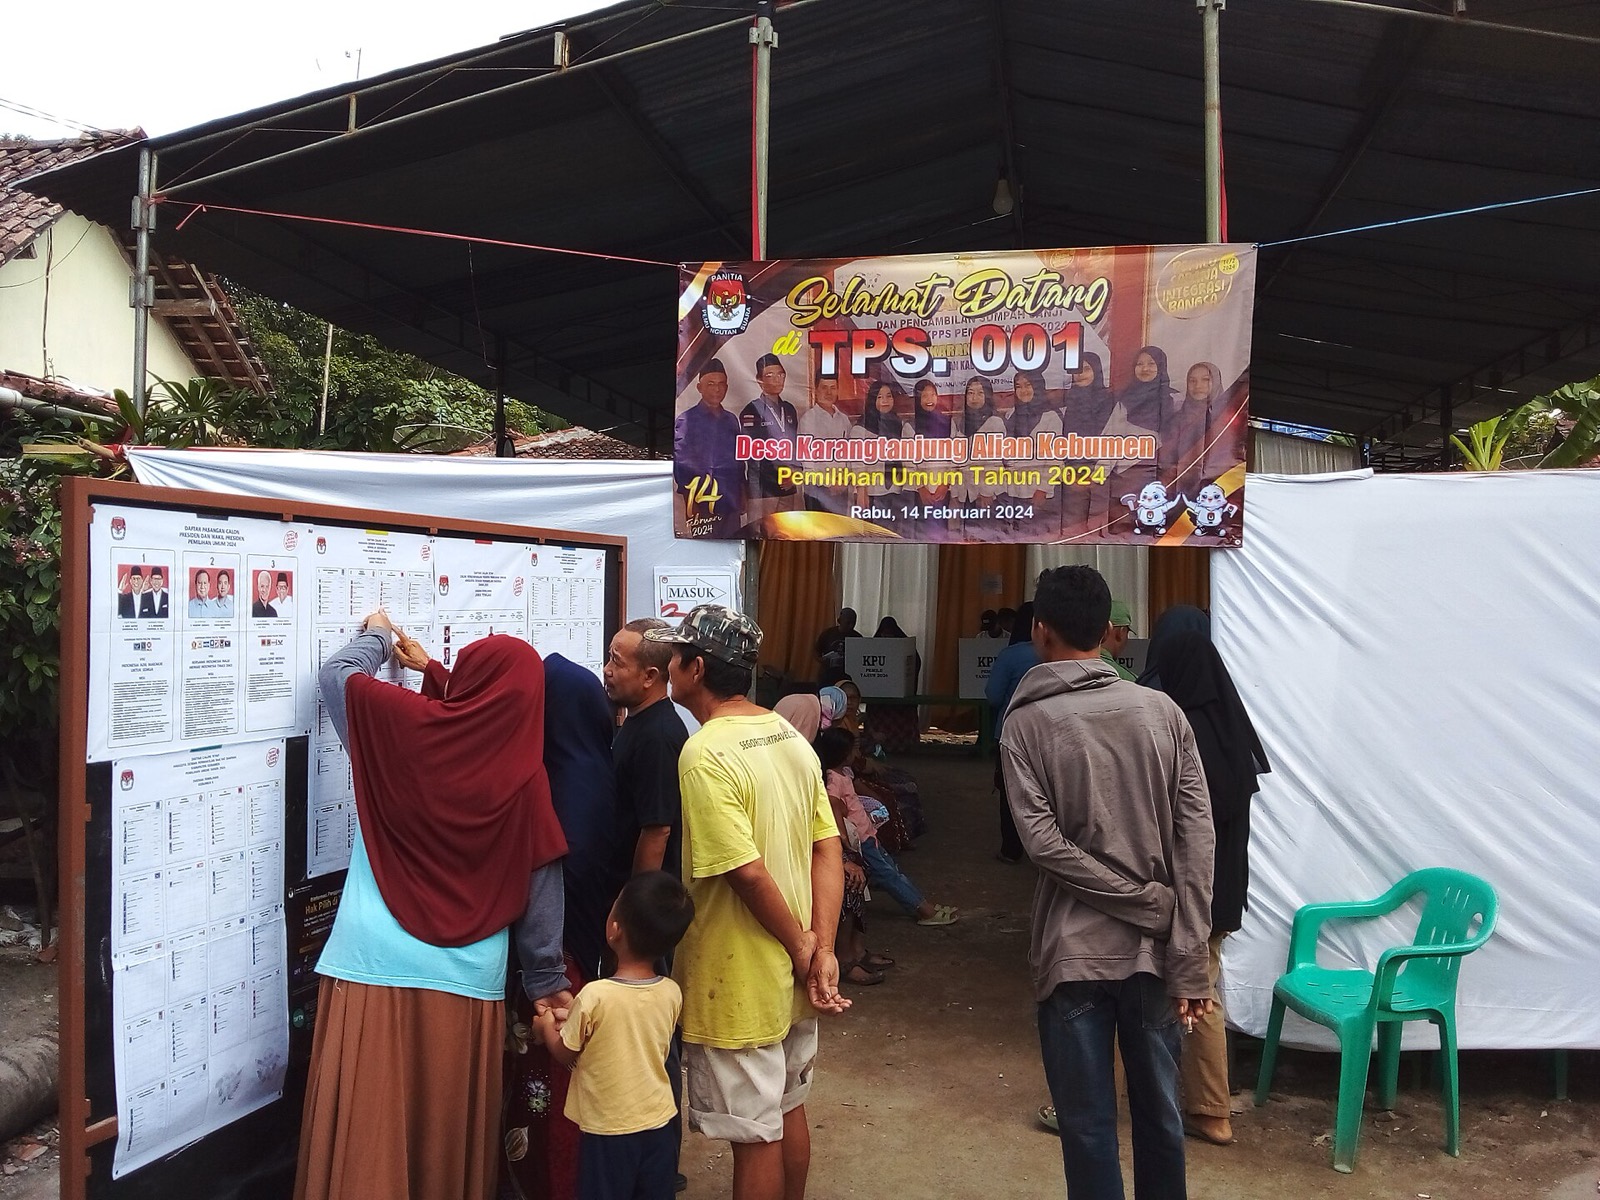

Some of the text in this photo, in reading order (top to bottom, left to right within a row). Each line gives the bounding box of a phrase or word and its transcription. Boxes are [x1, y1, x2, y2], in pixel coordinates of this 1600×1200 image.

[711, 273, 743, 282] PANITIA
[786, 267, 1112, 327] Selamat Datang
[1163, 279, 1225, 302] INTEGRASI
[740, 306, 752, 331] SUARA
[877, 320, 897, 330] DAN
[900, 315, 975, 328] PENGAMBILAN
[772, 321, 1085, 379] di TPS. 001
[735, 432, 1156, 464] Desa Karangtanjung Alian Kebumen
[777, 466, 1106, 486] Pemilihan Umum Tahun 2024
[685, 474, 723, 518] 14
[851, 505, 1034, 521] Rabu, 14 Februari 2024
[692, 525, 713, 536] 2024
[141, 553, 146, 563] 1
[210, 557, 215, 566] 2
[271, 560, 276, 568] 3
[668, 587, 716, 598] MASUK
[862, 656, 886, 667] KPU
[1117, 658, 1134, 668] PU
